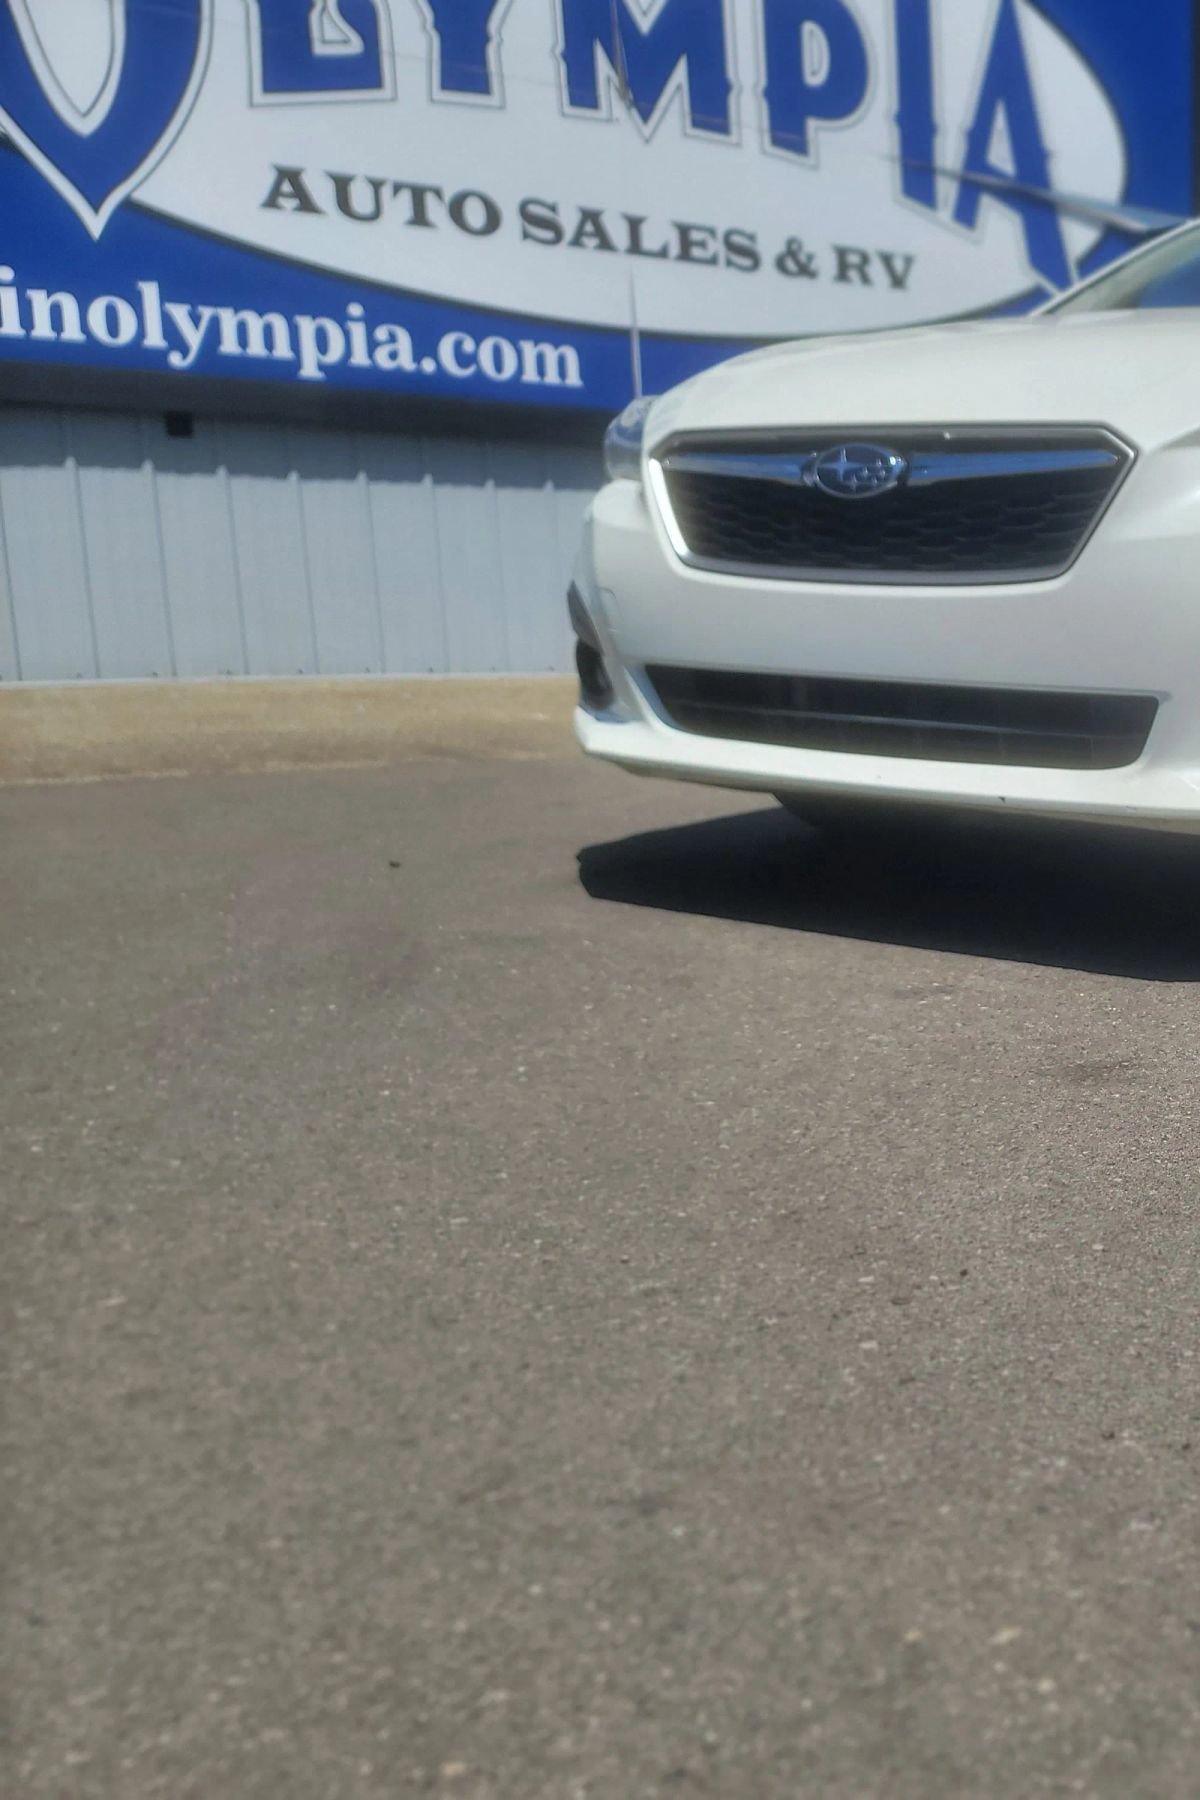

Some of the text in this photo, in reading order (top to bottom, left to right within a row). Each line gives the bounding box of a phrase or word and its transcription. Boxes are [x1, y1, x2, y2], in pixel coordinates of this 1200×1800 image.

[261, 164, 915, 291] AUTO SALES & RV
[0, 264, 583, 387] inolympia.com
